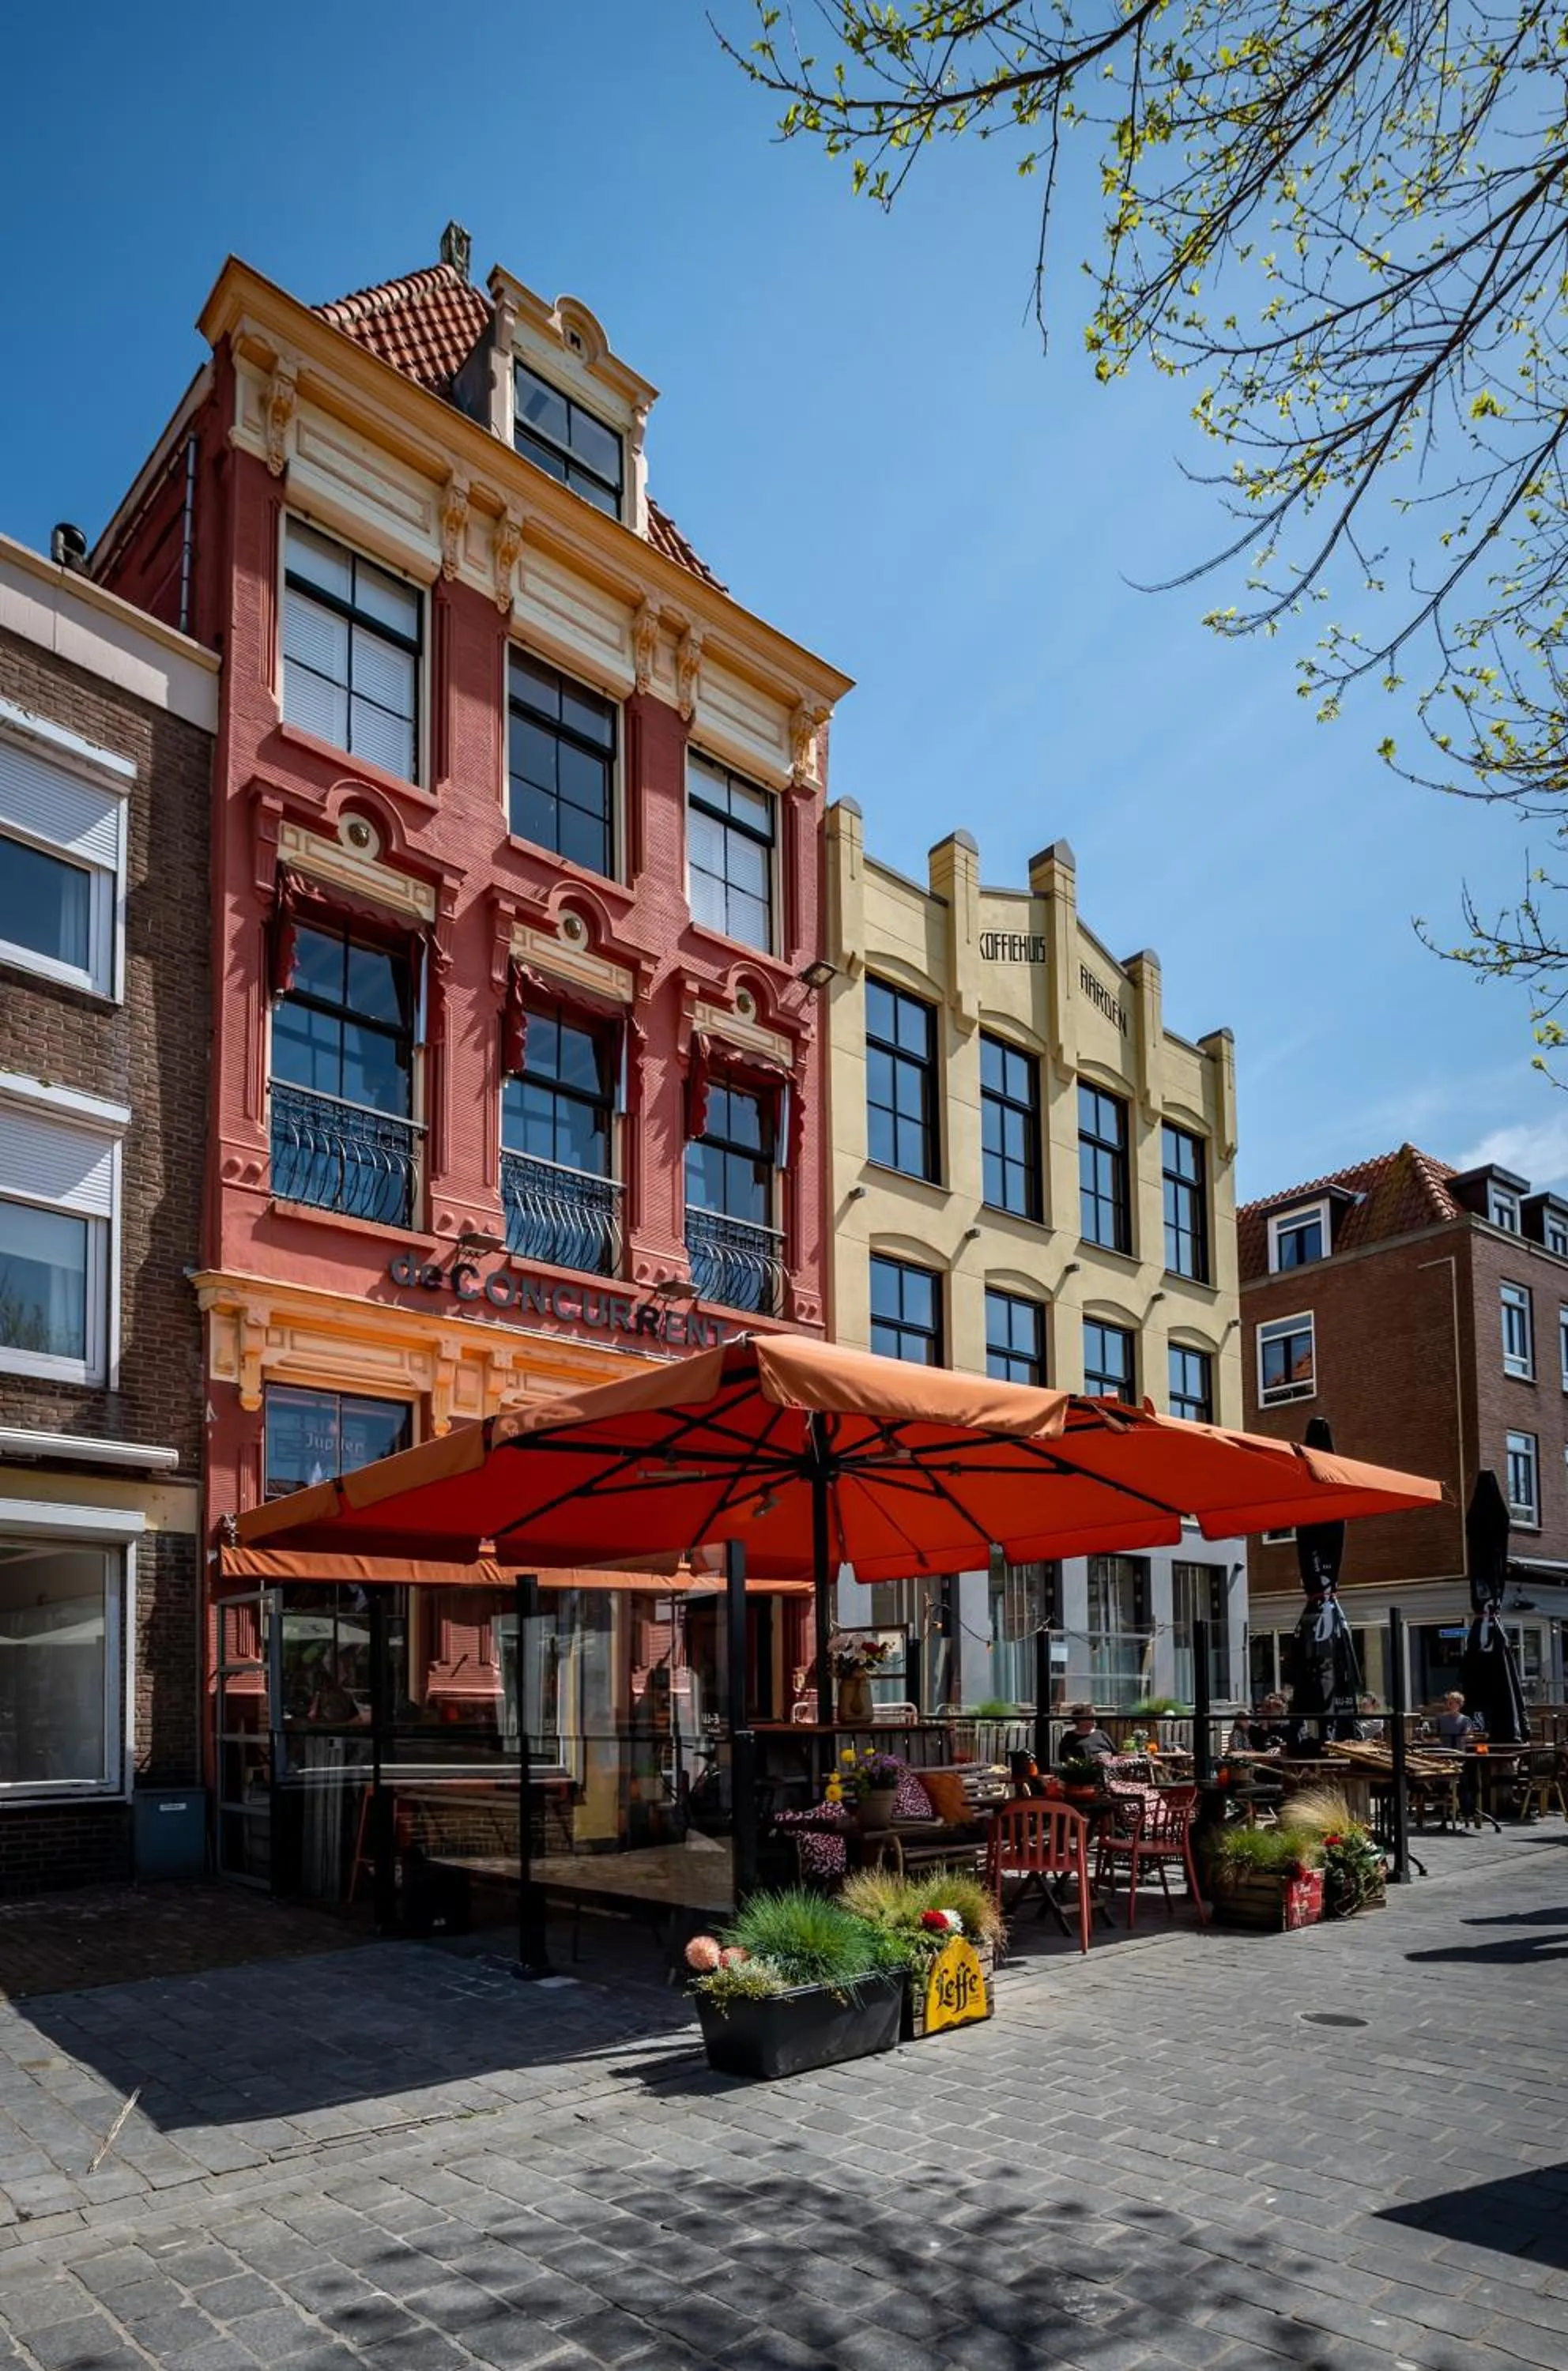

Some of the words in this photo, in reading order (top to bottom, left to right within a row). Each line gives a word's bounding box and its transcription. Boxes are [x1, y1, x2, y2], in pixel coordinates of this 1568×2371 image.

[979, 932, 1046, 963] KOFFIEHUIS
[1080, 963, 1128, 1038] AARDEN
[936, 1962, 978, 2015] Leffe
